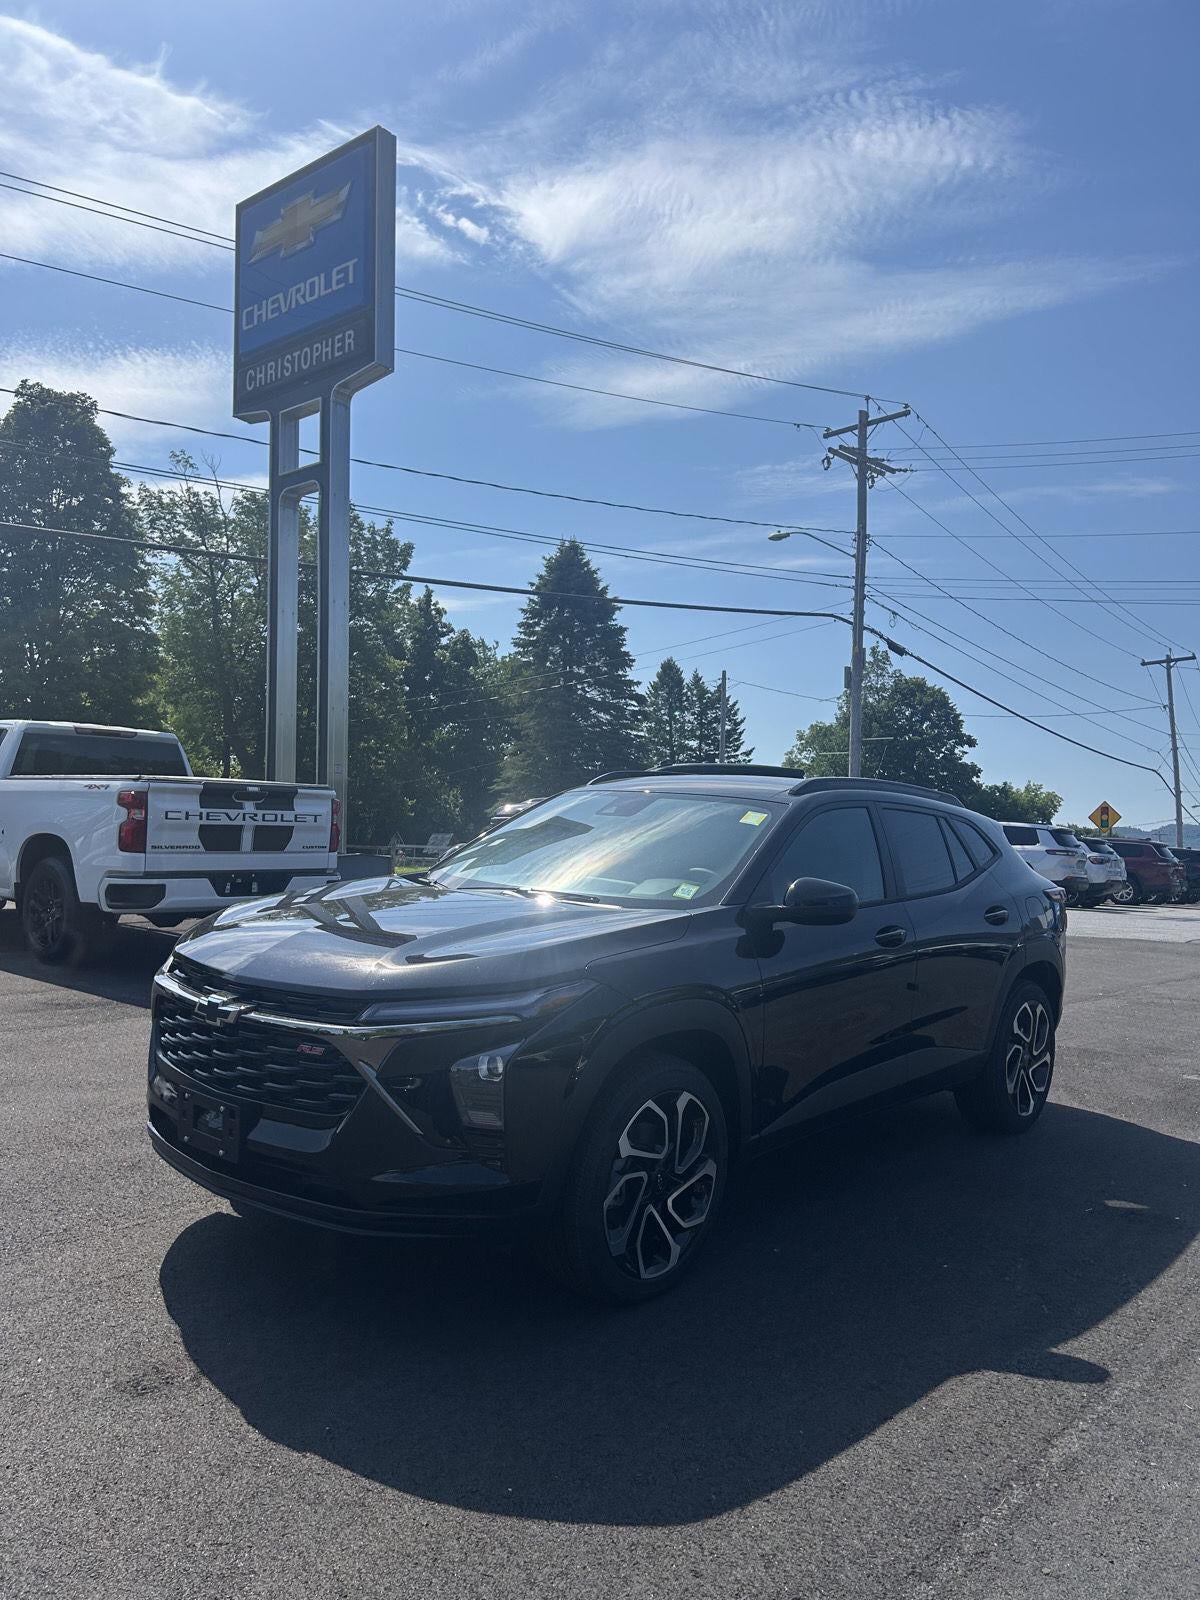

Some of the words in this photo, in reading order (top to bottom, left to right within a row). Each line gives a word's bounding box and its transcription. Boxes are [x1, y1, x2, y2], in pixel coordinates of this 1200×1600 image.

[242, 258, 358, 331] CHEVROLET
[246, 329, 355, 391] CHRISTOPHER
[164, 810, 323, 823] CHEVROLET
